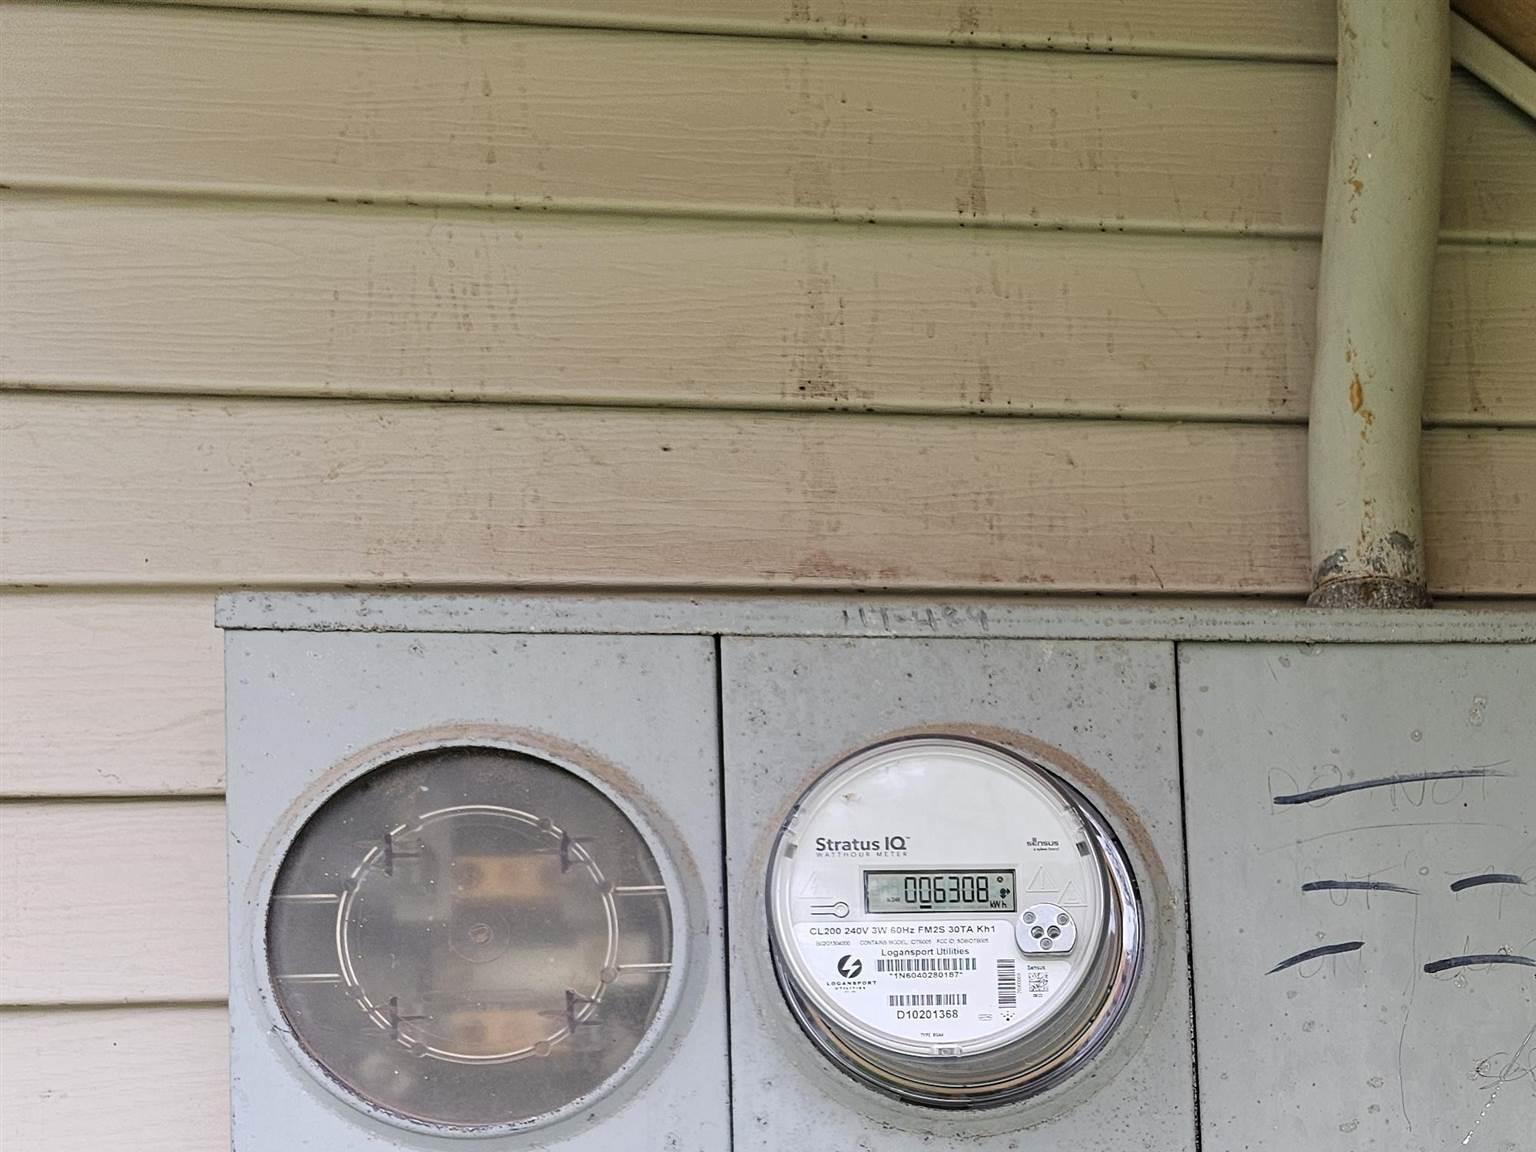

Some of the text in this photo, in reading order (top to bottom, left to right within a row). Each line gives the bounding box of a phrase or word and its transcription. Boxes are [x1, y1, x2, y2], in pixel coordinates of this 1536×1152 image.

[816, 837, 880, 851] Stratus
[905, 876, 989, 903] 006308
[977, 925, 996, 933] Kh1
[882, 948, 970, 957] Logansport Utilities
[897, 1010, 959, 1019] D10201368
